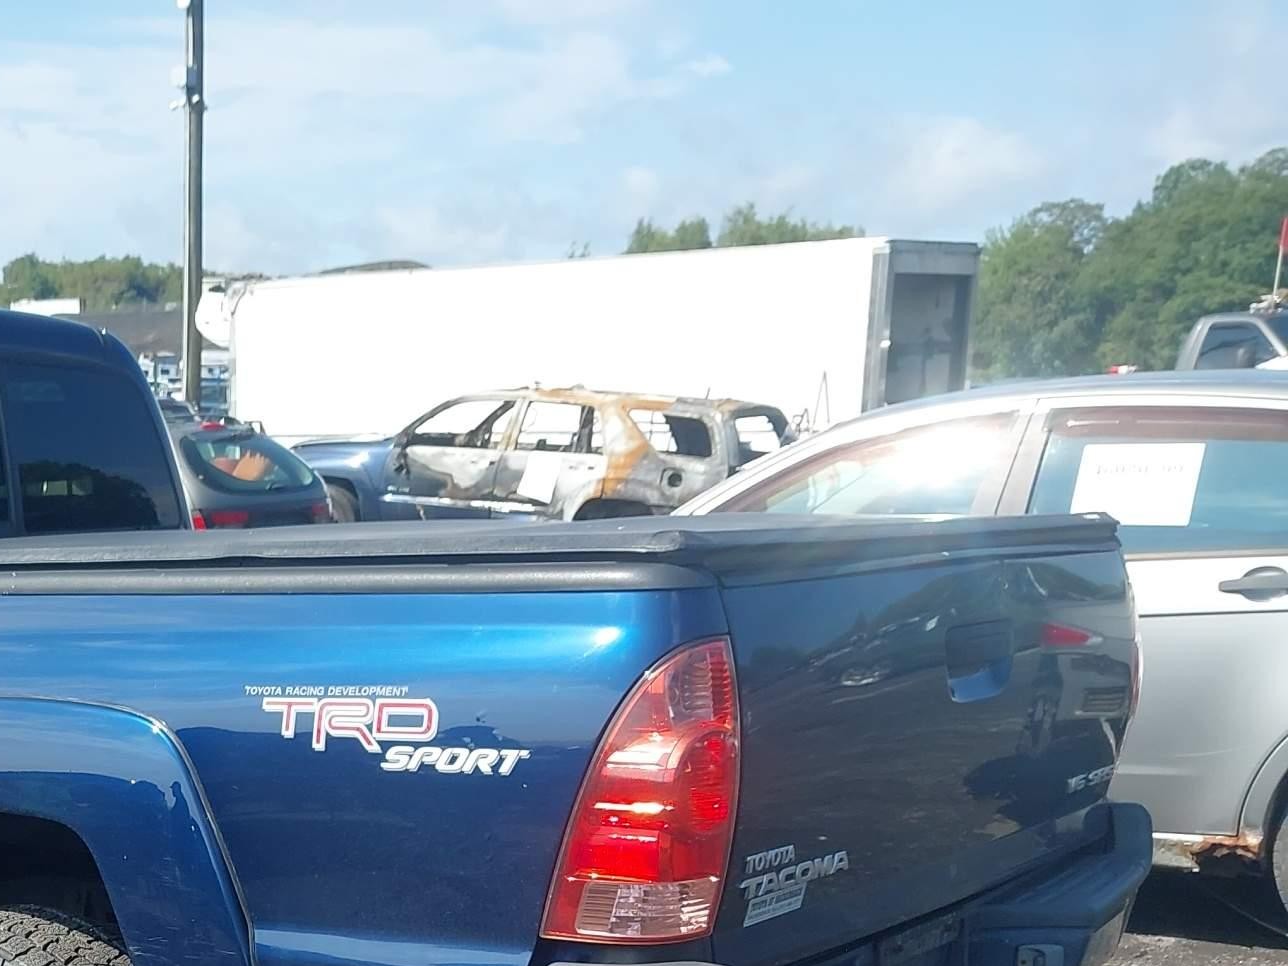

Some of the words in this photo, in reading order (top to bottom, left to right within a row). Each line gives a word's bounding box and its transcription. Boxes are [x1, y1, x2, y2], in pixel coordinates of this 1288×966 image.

[244, 685, 282, 696] TOYOTA
[285, 685, 324, 697] RACING
[327, 685, 409, 697] DEVELOPMENT
[262, 697, 438, 754] TRD
[380, 746, 532, 776] SPORT
[744, 844, 796, 874] TOYOTA
[739, 850, 849, 899] TACOMA
